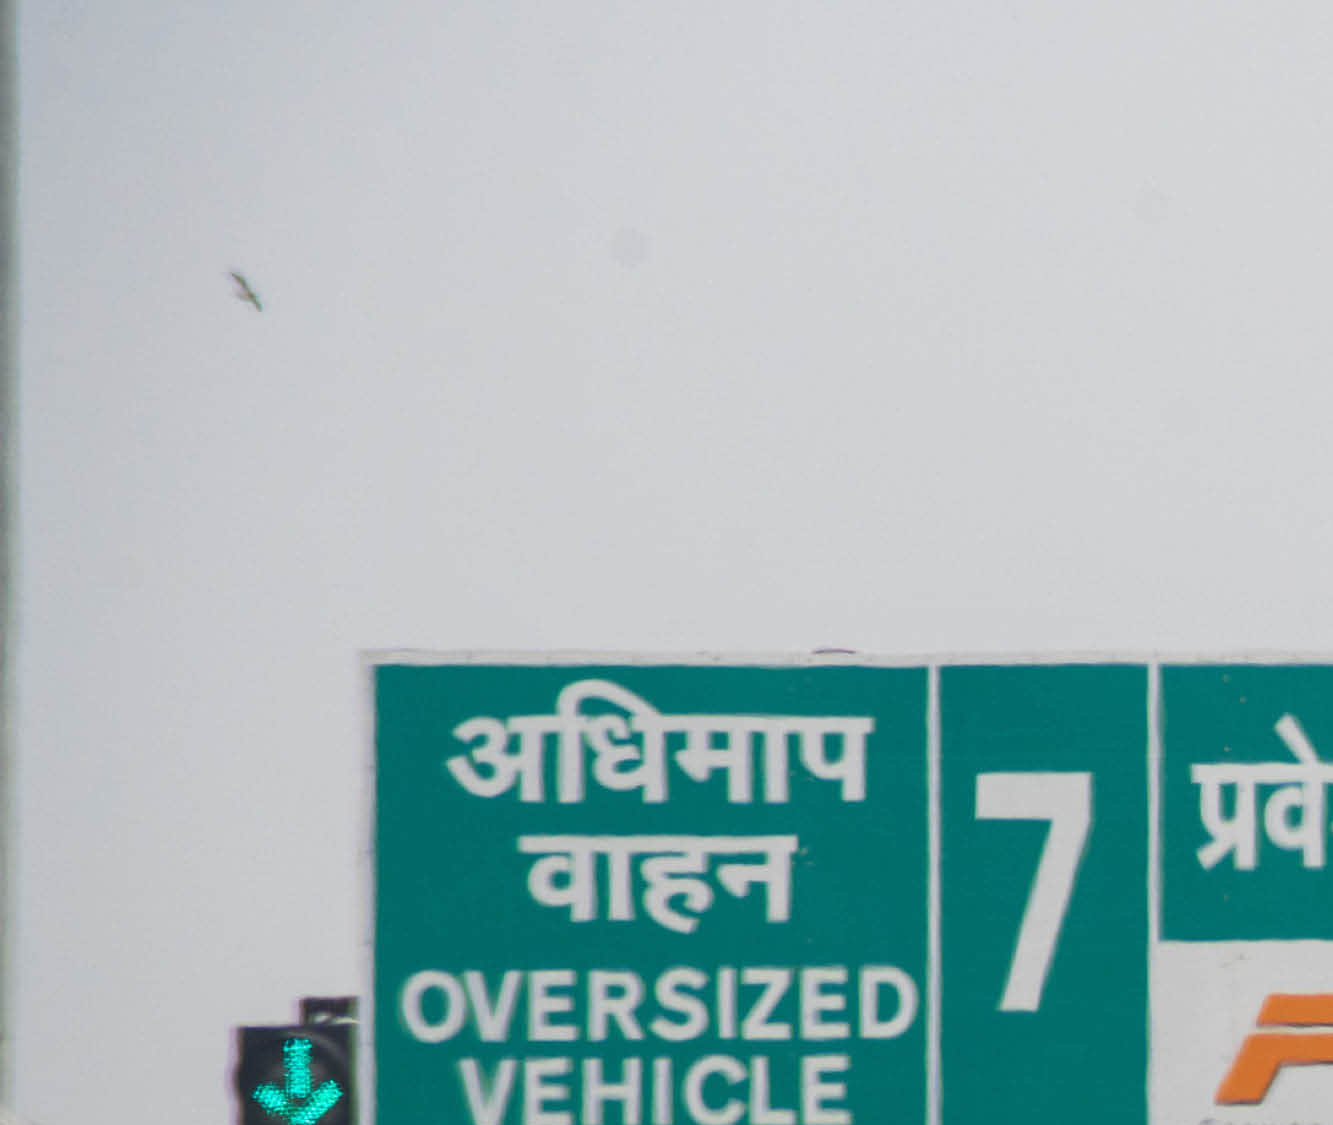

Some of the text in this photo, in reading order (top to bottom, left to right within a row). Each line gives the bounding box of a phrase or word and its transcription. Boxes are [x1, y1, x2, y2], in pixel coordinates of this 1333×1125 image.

[447, 679, 875, 803] अधिमाप
[519, 835, 799, 933] वाहन
[975, 772, 1093, 1012] 7
[402, 966, 920, 1044] OVERSIZED
